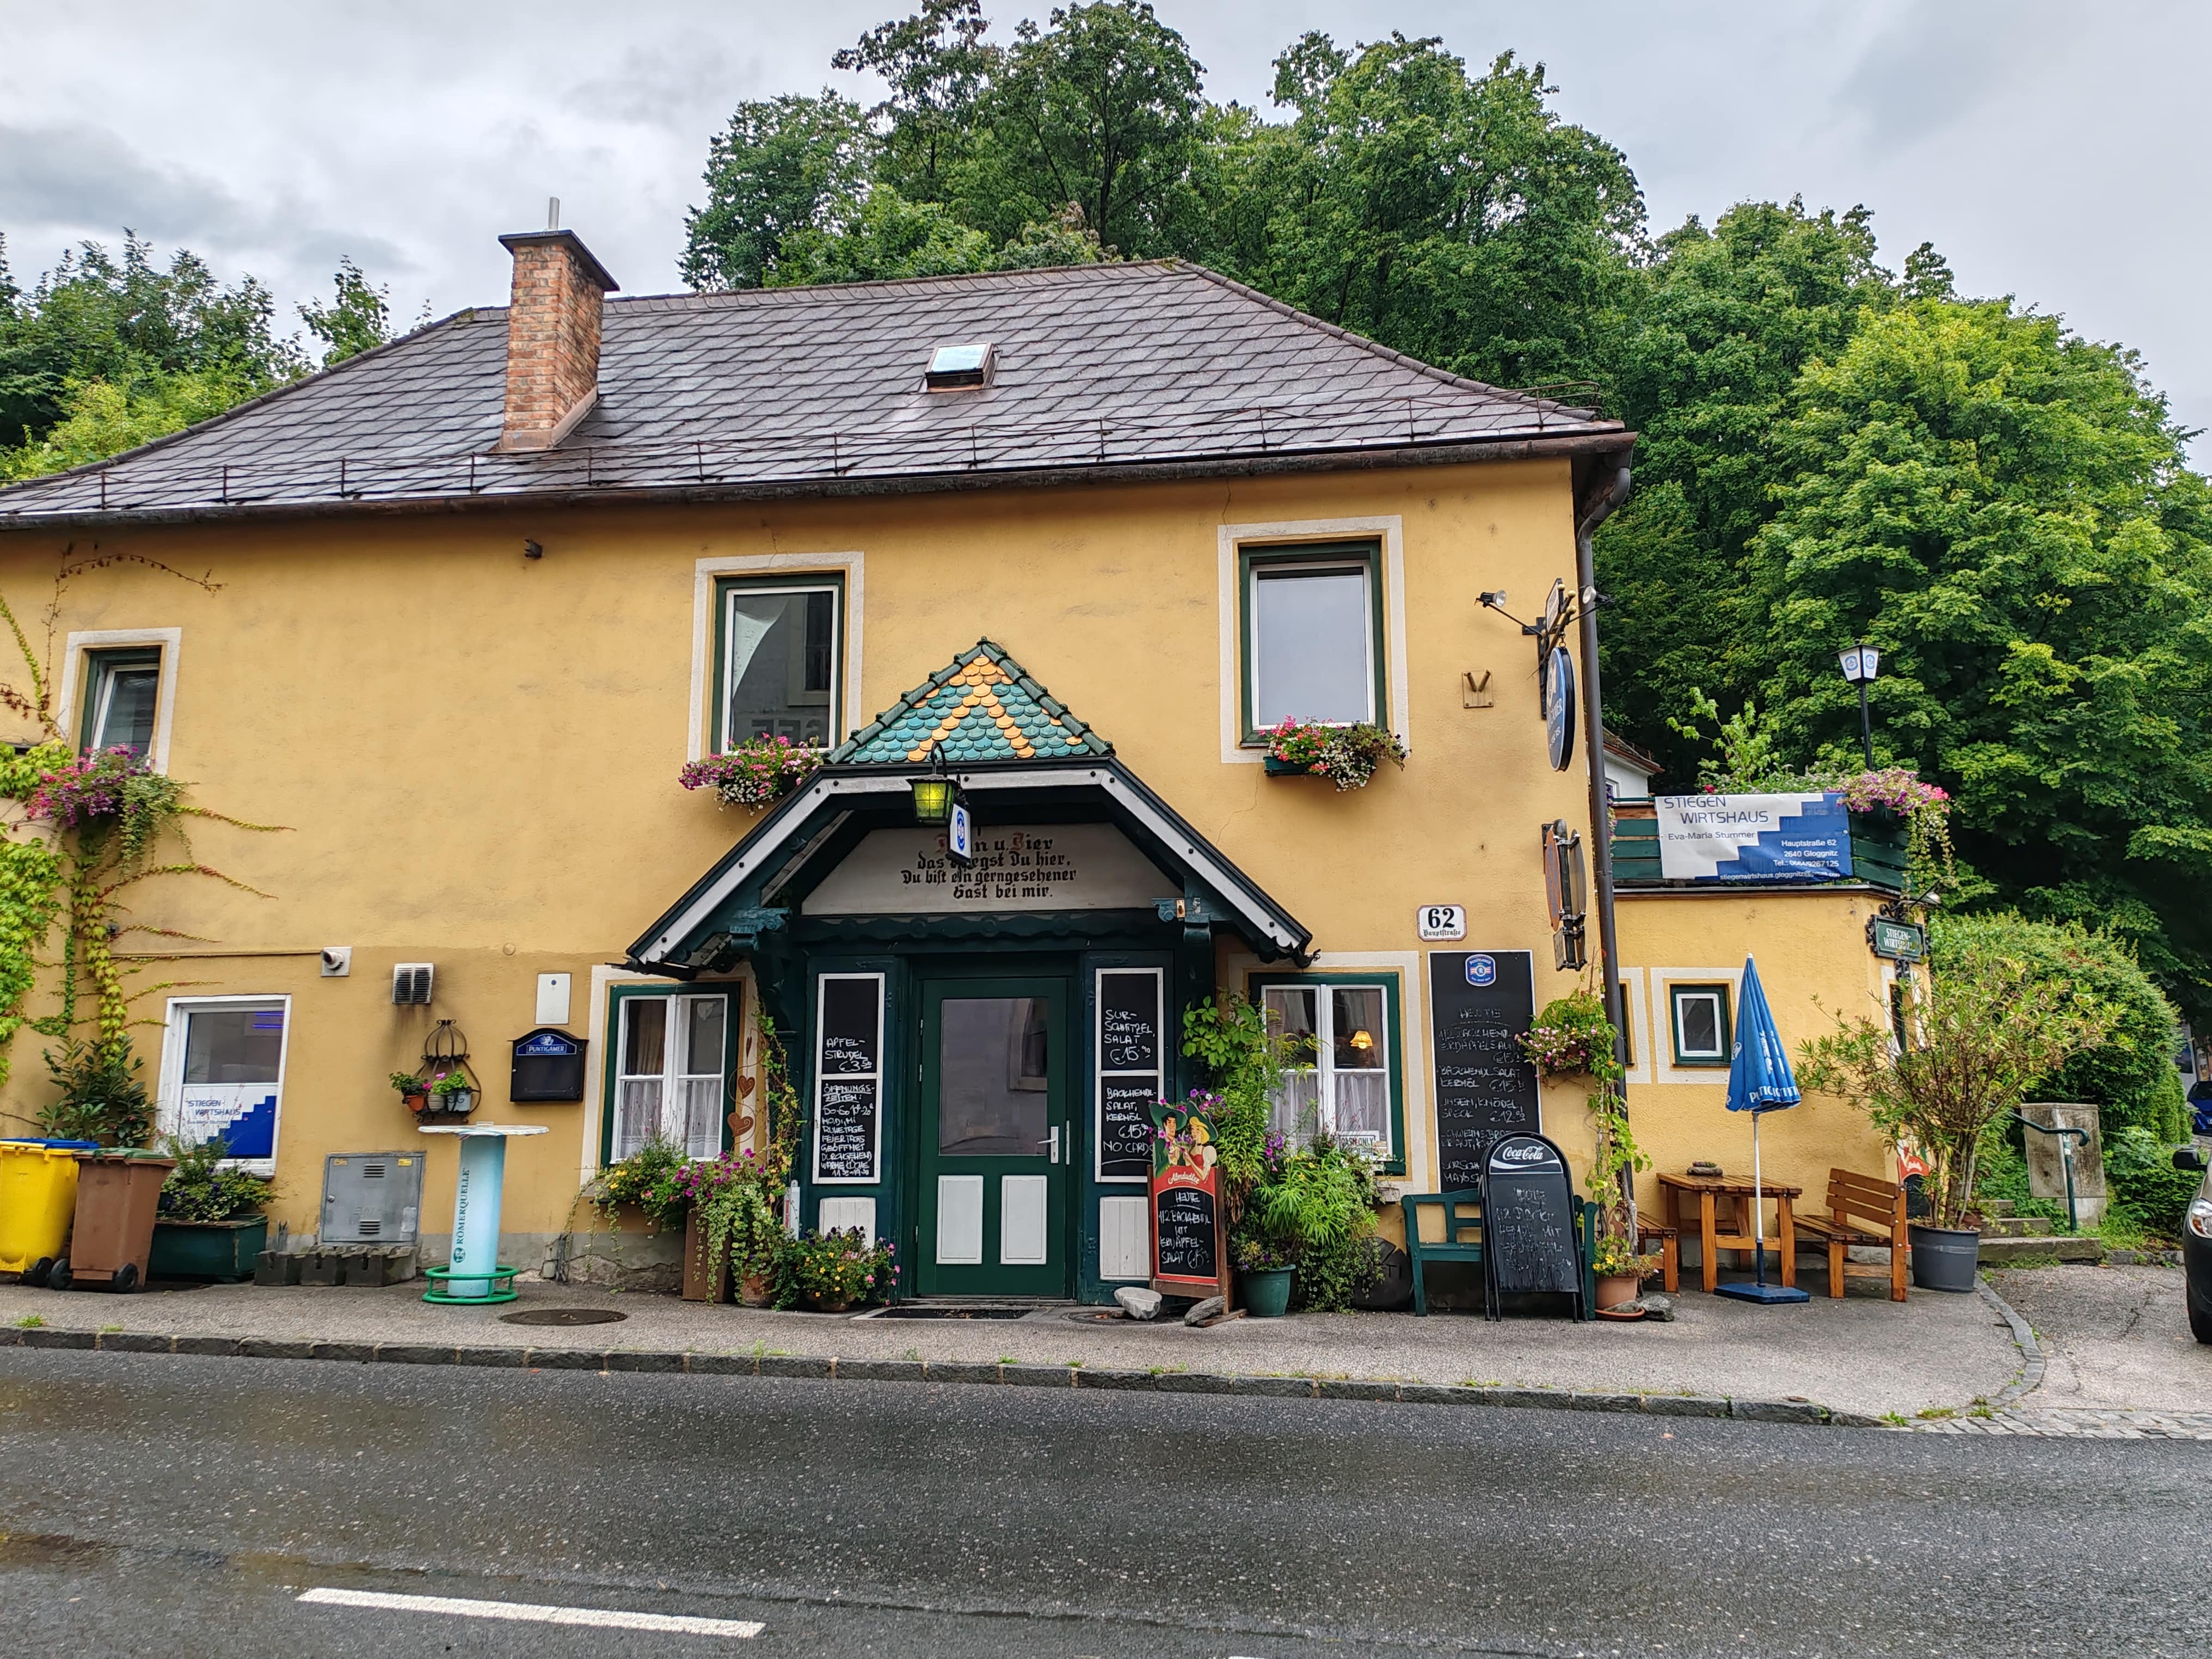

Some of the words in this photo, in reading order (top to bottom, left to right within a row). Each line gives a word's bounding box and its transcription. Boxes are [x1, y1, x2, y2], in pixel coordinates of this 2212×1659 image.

[1664, 796, 1726, 809] STIEGEN
[1681, 810, 1768, 824] WIRTSHAUS
[1668, 832, 1712, 840] Eva-Maria
[1781, 839, 1826, 847] Hauptstraße
[918, 850, 944, 869] das
[950, 852, 1004, 871] egst
[1009, 850, 1031, 867] Du
[901, 870, 921, 884] Du
[974, 869, 1076, 886] gerngesehener
[954, 883, 987, 899] Gast
[996, 884, 1016, 898] bei
[1022, 883, 1053, 897] mir.
[1428, 908, 1455, 929] 62
[1886, 927, 1912, 941] STIEGEN-
[1105, 1009, 1137, 1021] SUR-
[826, 1037, 865, 1048] APFEL-
[1104, 1034, 1140, 1044] SALAT
[825, 1050, 868, 1061] STRUDEL
[1103, 1140, 1122, 1152] NO
[1358, 1138, 1373, 1146] ONLY
[1502, 1146, 1545, 1160] Coca-Cola
[1168, 1172, 1200, 1184] Almdudler
[1176, 1191, 1200, 1203] HEUTE
[456, 1168, 470, 1245] RÖMERQUELLE
